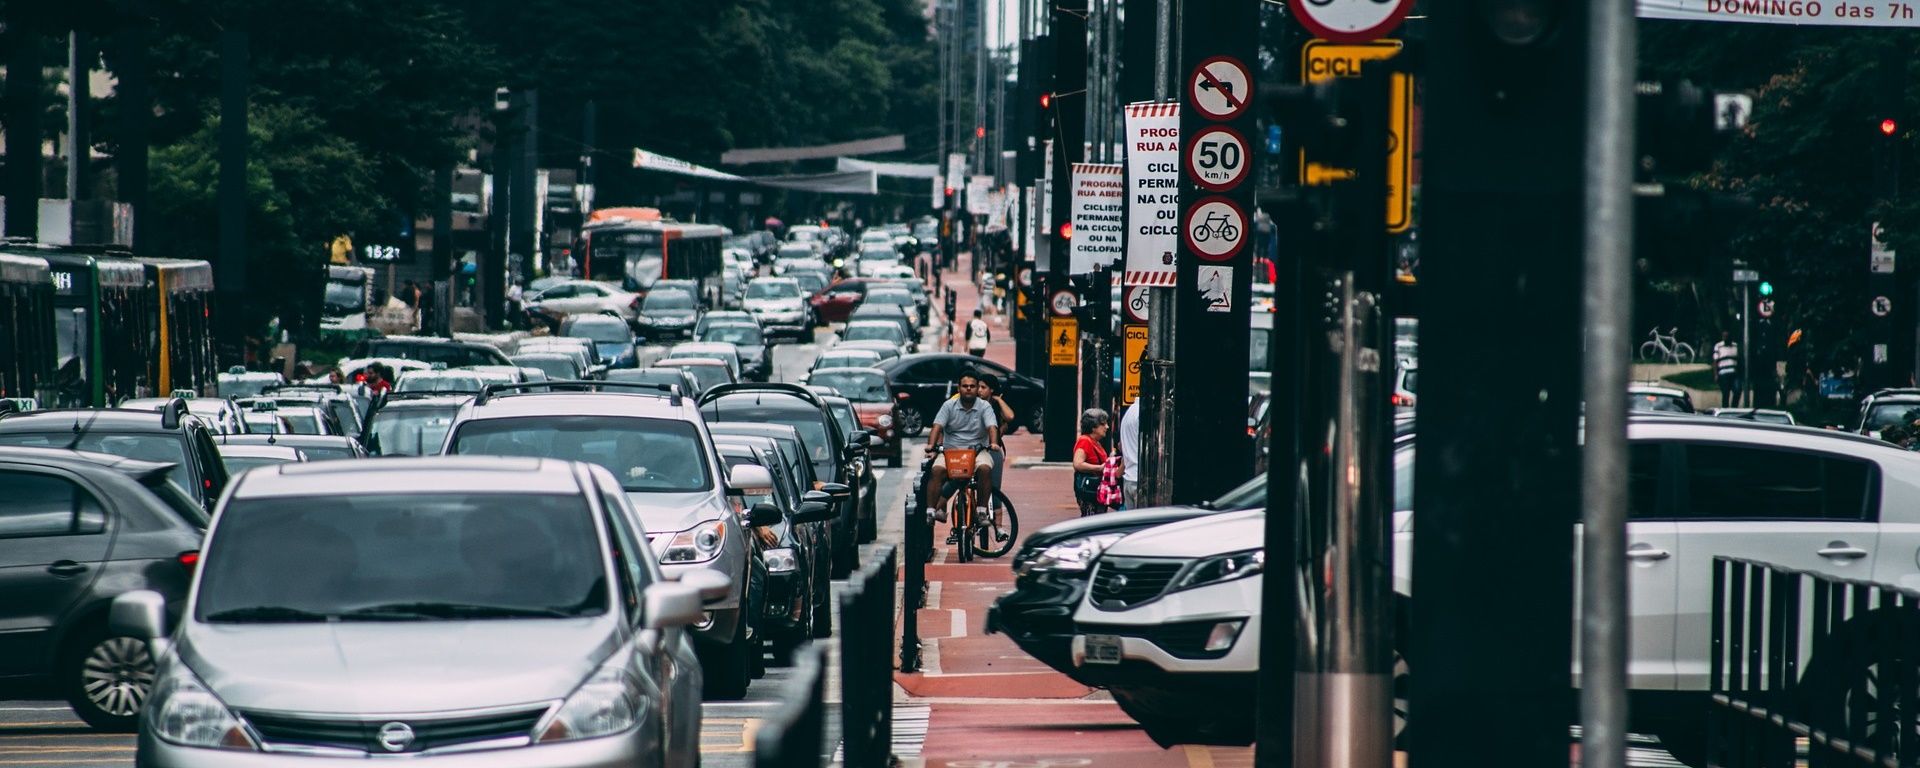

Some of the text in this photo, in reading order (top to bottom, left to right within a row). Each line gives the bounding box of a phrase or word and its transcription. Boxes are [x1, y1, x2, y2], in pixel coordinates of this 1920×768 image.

[1708, 0, 1914, 19] DOMINGO das 7h
[1140, 128, 1180, 137] PROG
[1137, 142, 1164, 151] RUA
[1199, 142, 1239, 170] 50
[1147, 163, 1178, 173] CICL
[1205, 171, 1229, 179] km/h
[1138, 194, 1156, 204] NA
[1157, 210, 1175, 219] OU
[1127, 331, 1148, 339] CICL
